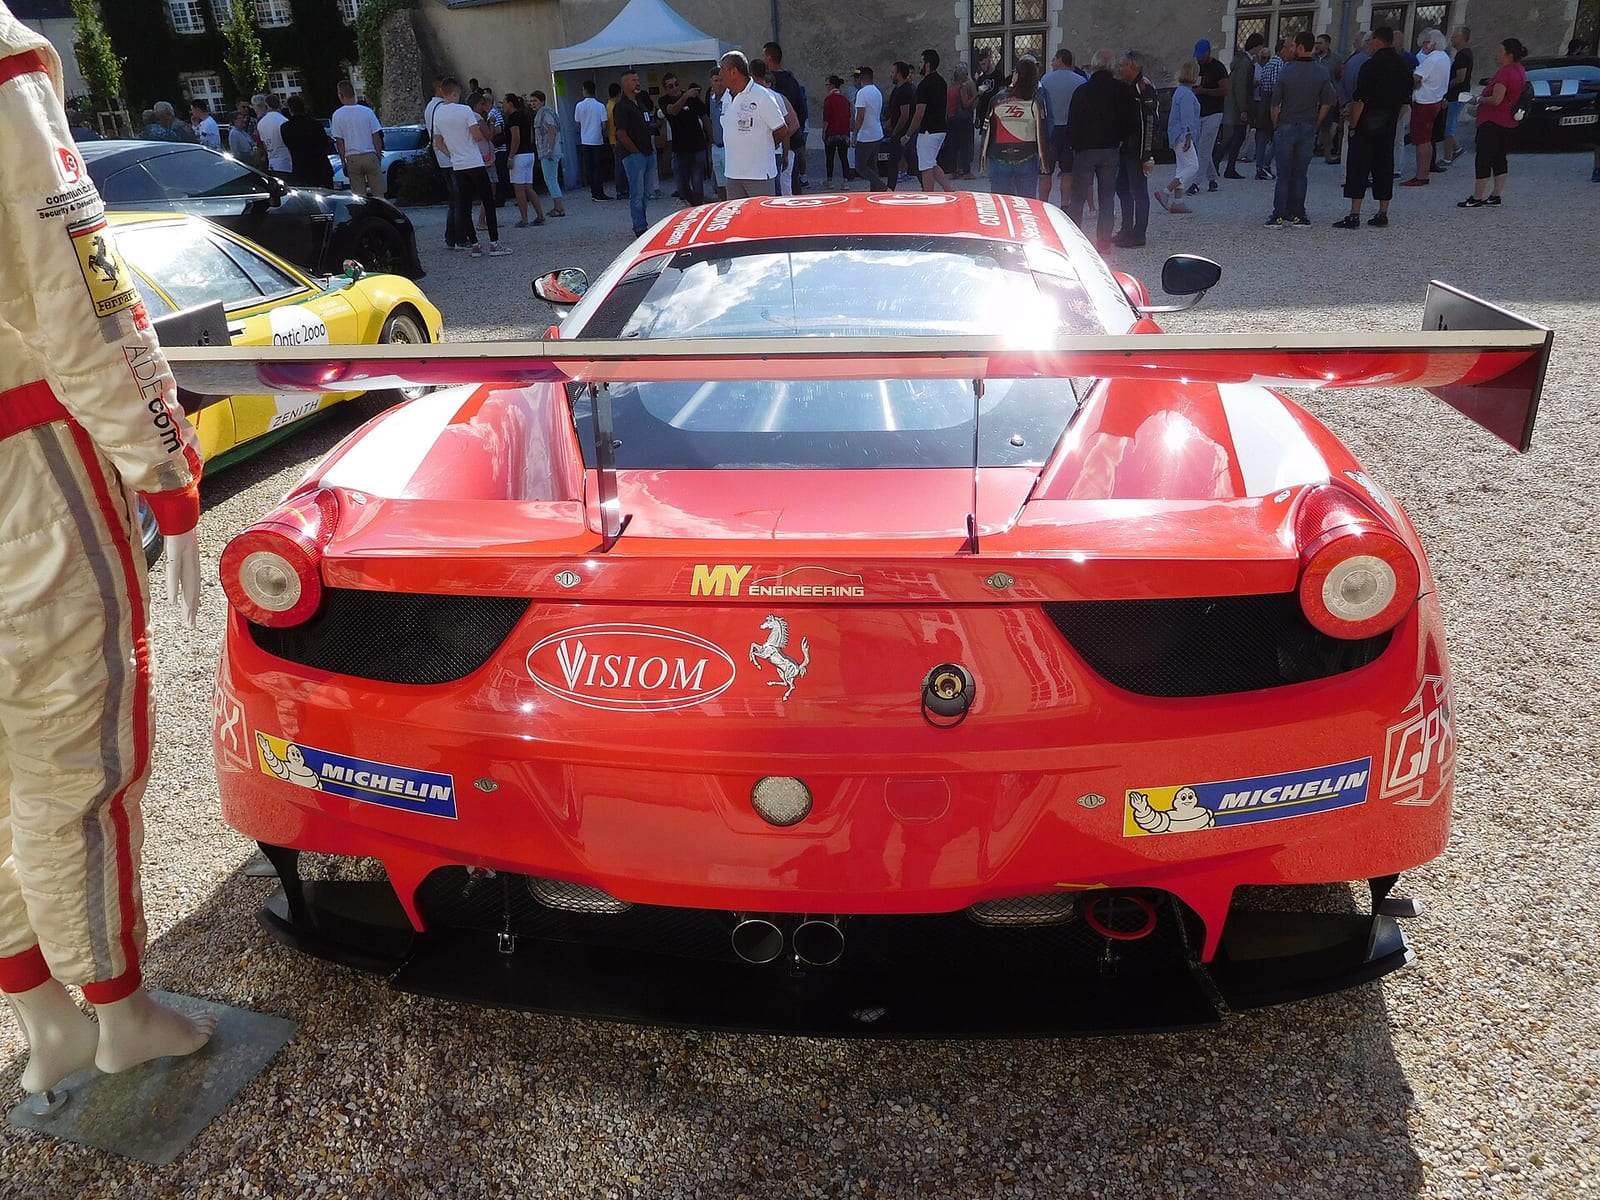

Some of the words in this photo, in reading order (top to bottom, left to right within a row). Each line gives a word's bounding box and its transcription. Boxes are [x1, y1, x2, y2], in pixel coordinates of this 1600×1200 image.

[39, 207, 69, 219] Security
[69, 204, 76, 212] &
[96, 290, 138, 312] Ferrari
[302, 323, 326, 342] 2000
[273, 398, 319, 428] ZENITH
[690, 565, 752, 596] MY
[748, 585, 865, 597] ENGINEERING
[555, 639, 709, 692] VISIOM
[1388, 693, 1453, 788] GPX
[321, 762, 451, 801] MICHELIN
[1218, 770, 1368, 810] MICHELIN
